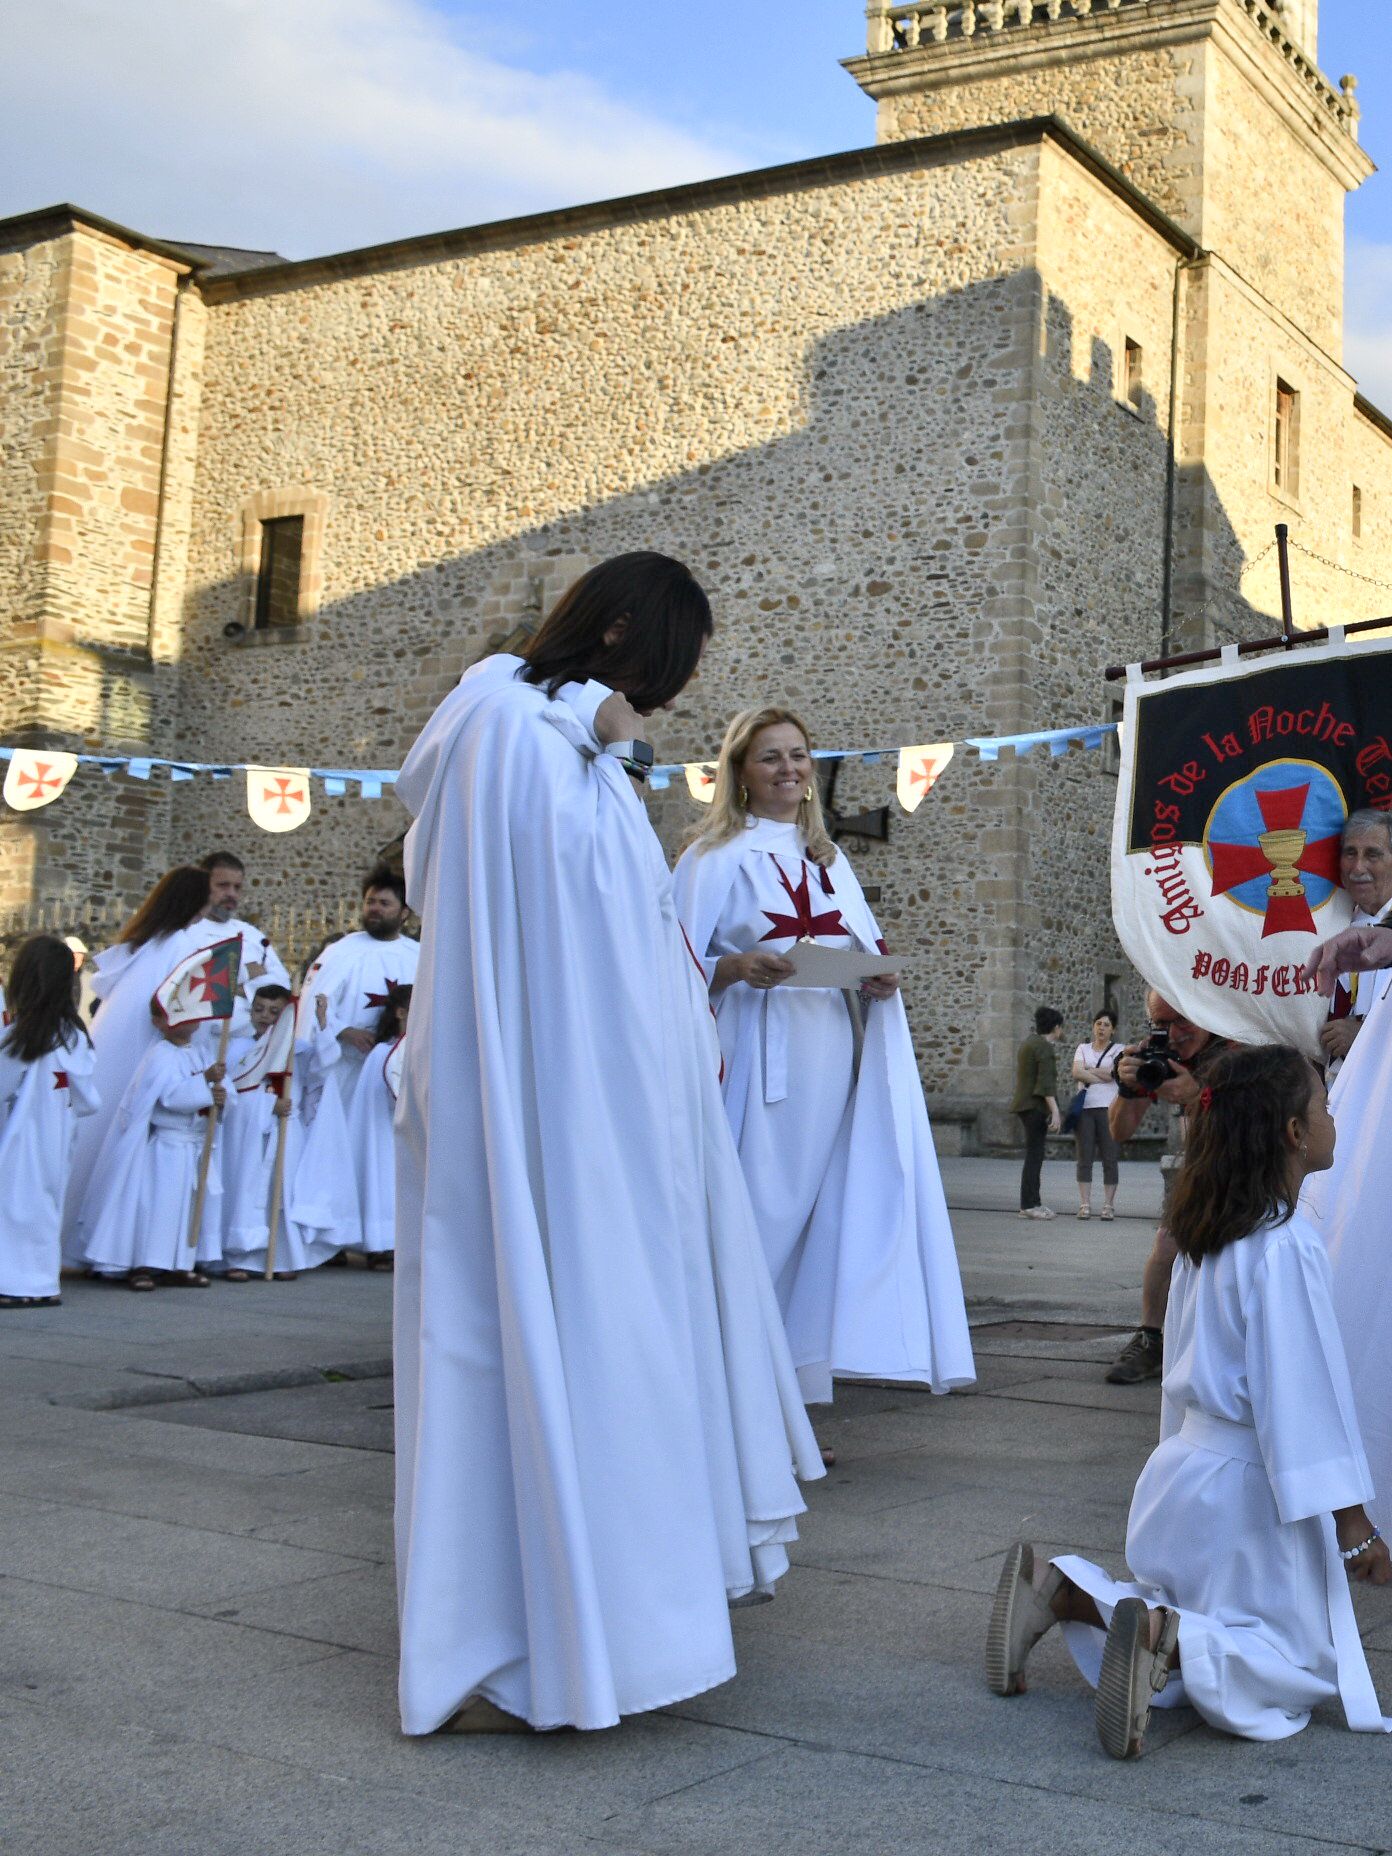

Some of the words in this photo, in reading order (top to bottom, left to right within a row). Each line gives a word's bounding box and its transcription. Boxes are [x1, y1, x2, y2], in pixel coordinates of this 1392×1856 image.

[1248, 701, 1356, 745] Noche
[1200, 732, 1244, 763] la
[1158, 761, 1206, 795] de
[1145, 800, 1204, 934] Amigos
[1190, 949, 1319, 997] PONFER
